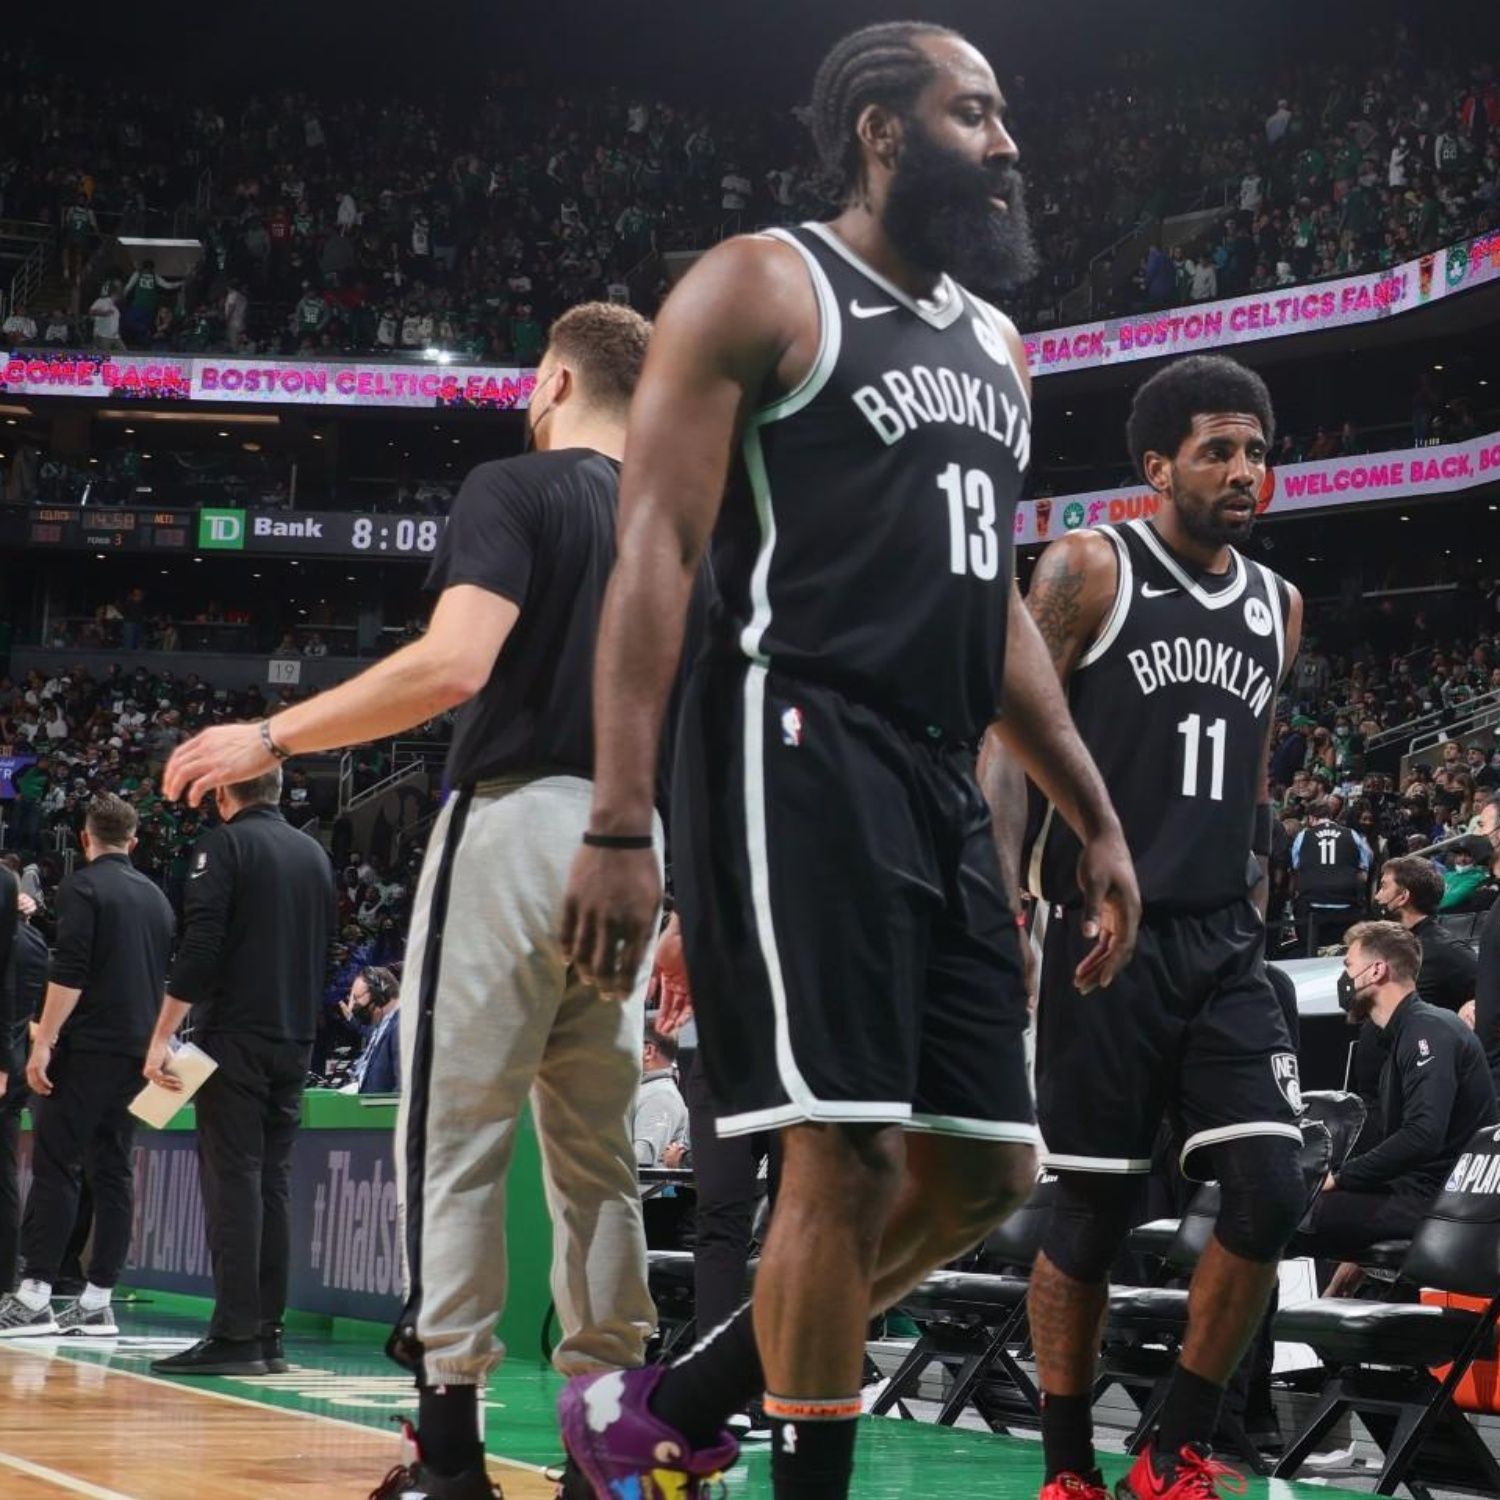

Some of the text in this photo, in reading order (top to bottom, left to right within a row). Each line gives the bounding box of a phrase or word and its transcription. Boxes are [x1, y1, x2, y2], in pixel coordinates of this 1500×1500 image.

[1119, 310, 1223, 352] BOSTON
[1229, 289, 1335, 332] CELTICS
[0, 359, 95, 387] COME
[202, 367, 327, 395] BOSTON
[336, 372, 458, 399] CELTICS
[852, 365, 1030, 472] BROOKLYN
[1284, 462, 1403, 498] WELCOME
[1410, 454, 1475, 483] BACK,
[204, 516, 240, 541] TD
[254, 517, 324, 538] Bank
[351, 518, 437, 551] 8:08
[936, 462, 998, 581] 13
[275, 662, 296, 680] 19
[1127, 637, 1273, 719] BROOKLYN
[1177, 713, 1227, 801] 11
[1318, 838, 1335, 864] 11
